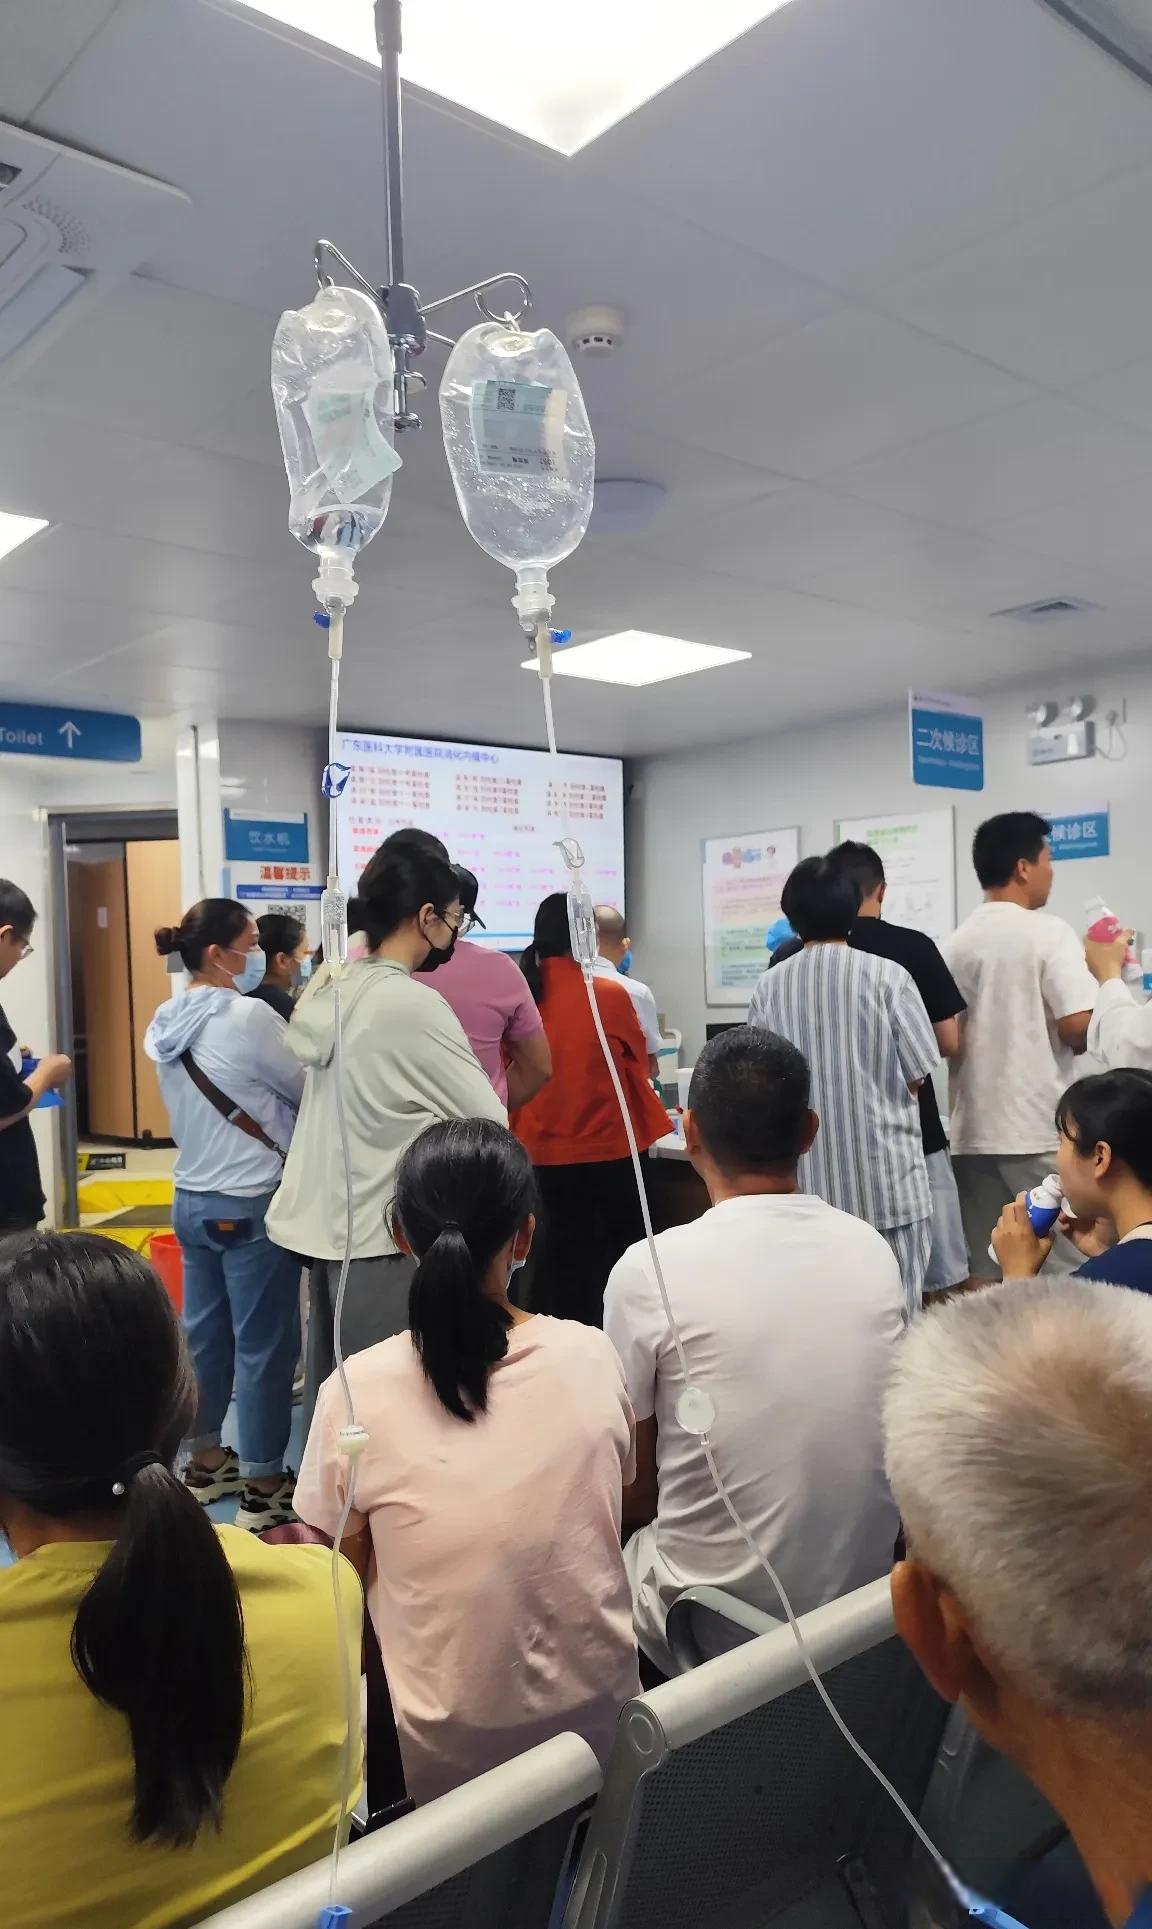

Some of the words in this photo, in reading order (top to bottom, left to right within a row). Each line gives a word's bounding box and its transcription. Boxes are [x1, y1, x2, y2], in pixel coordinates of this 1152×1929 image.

[0, 727, 43, 746] Toilet
[916, 728, 980, 755] 二次候诊区
[260, 866, 311, 881] 温馨提示
